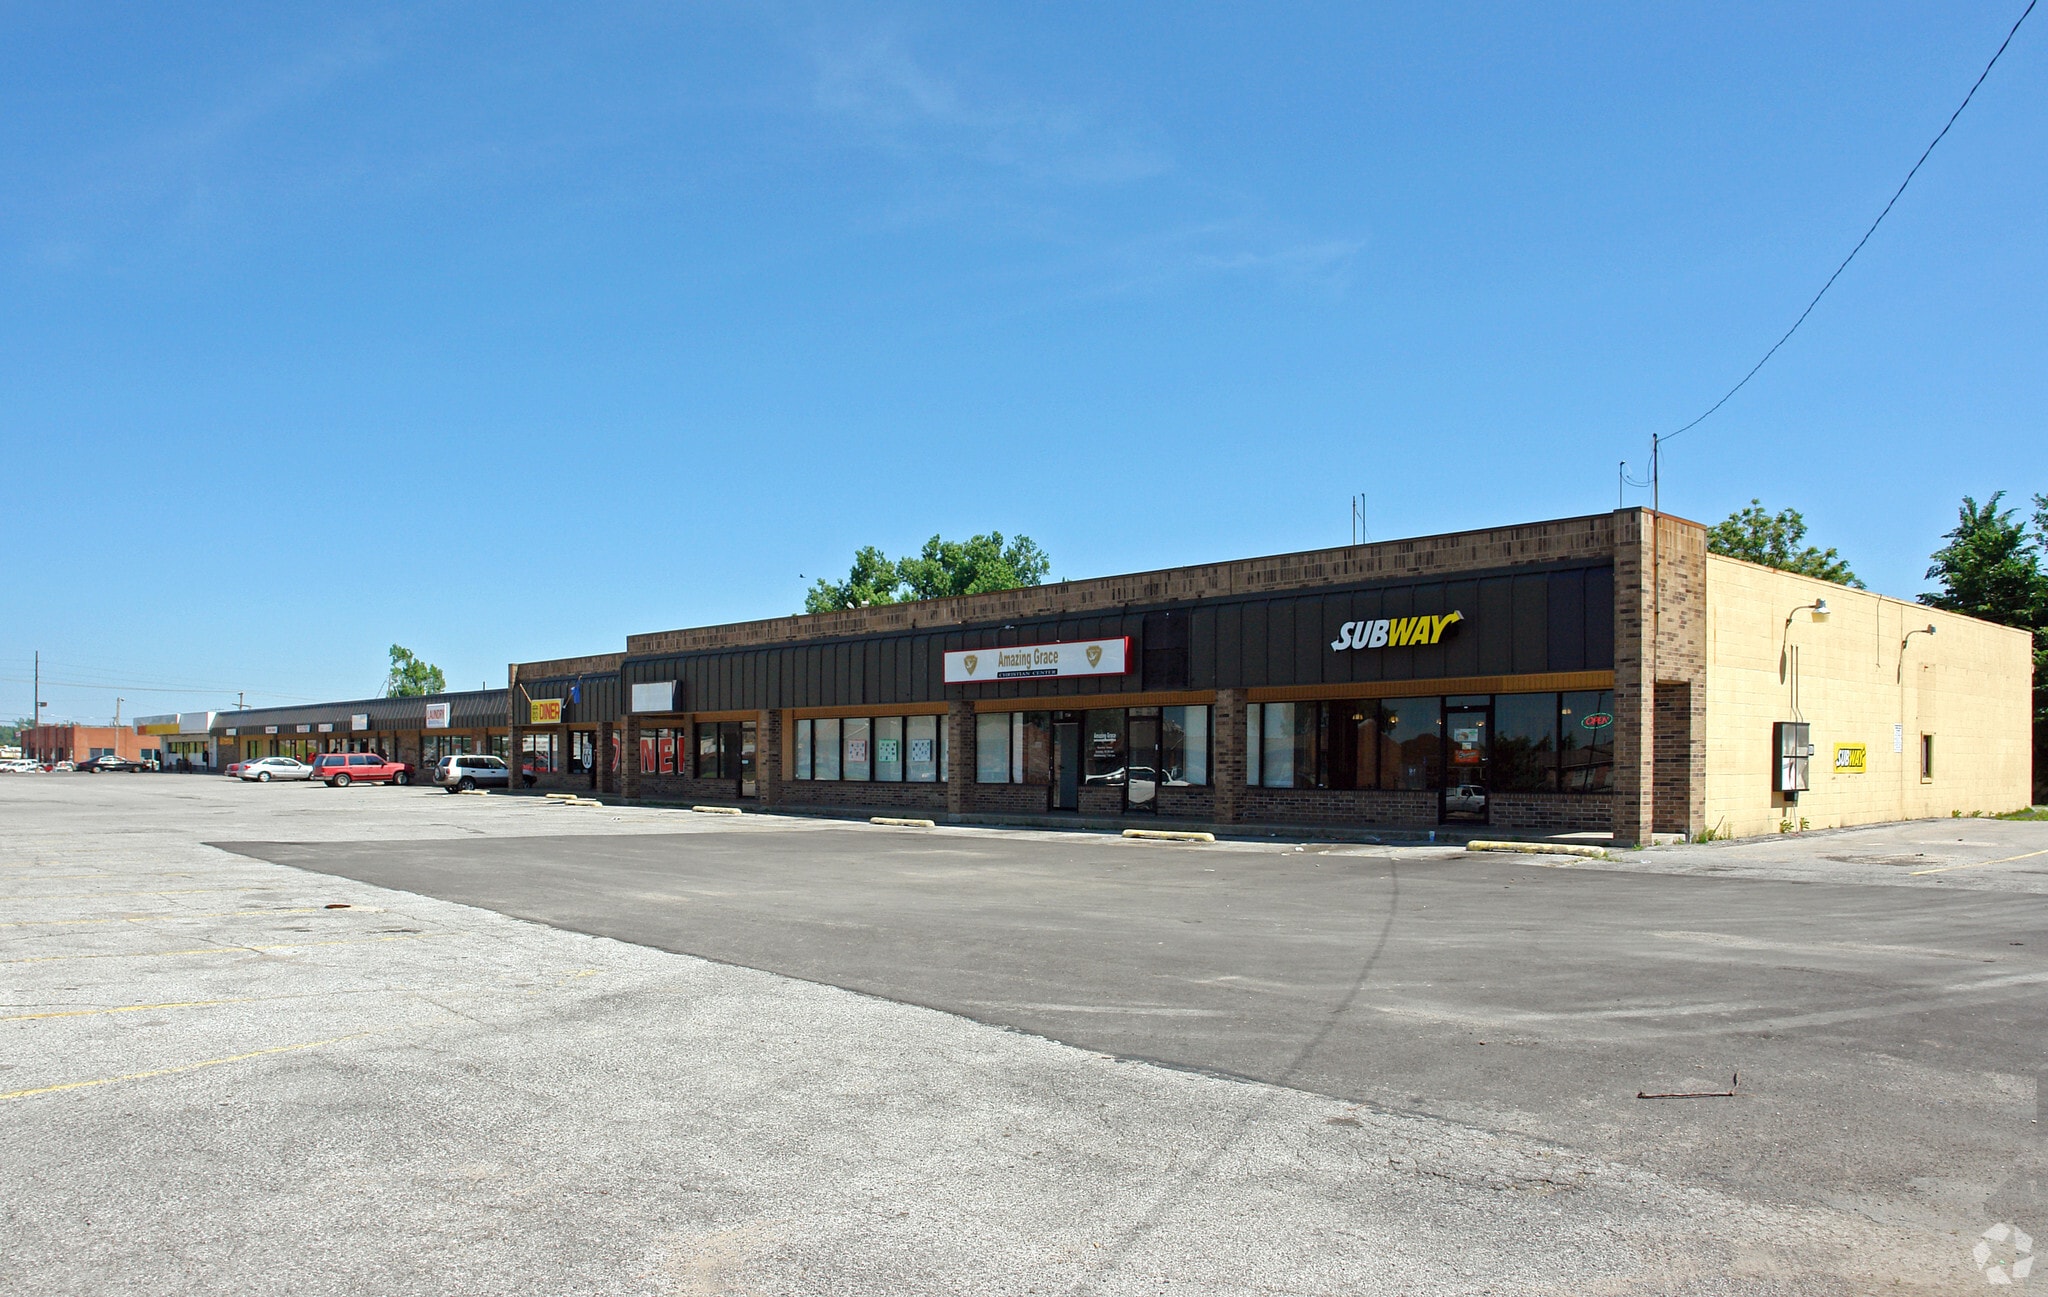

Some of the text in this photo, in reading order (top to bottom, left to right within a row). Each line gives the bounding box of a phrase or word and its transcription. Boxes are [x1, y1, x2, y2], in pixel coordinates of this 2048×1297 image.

[1331, 610, 1464, 652] SUBWAY
[998, 648, 1059, 669] Amazing Grace
[539, 702, 560, 720] DINER
[1585, 715, 1610, 726] OPEN
[1835, 747, 1867, 769] SUBWAY
